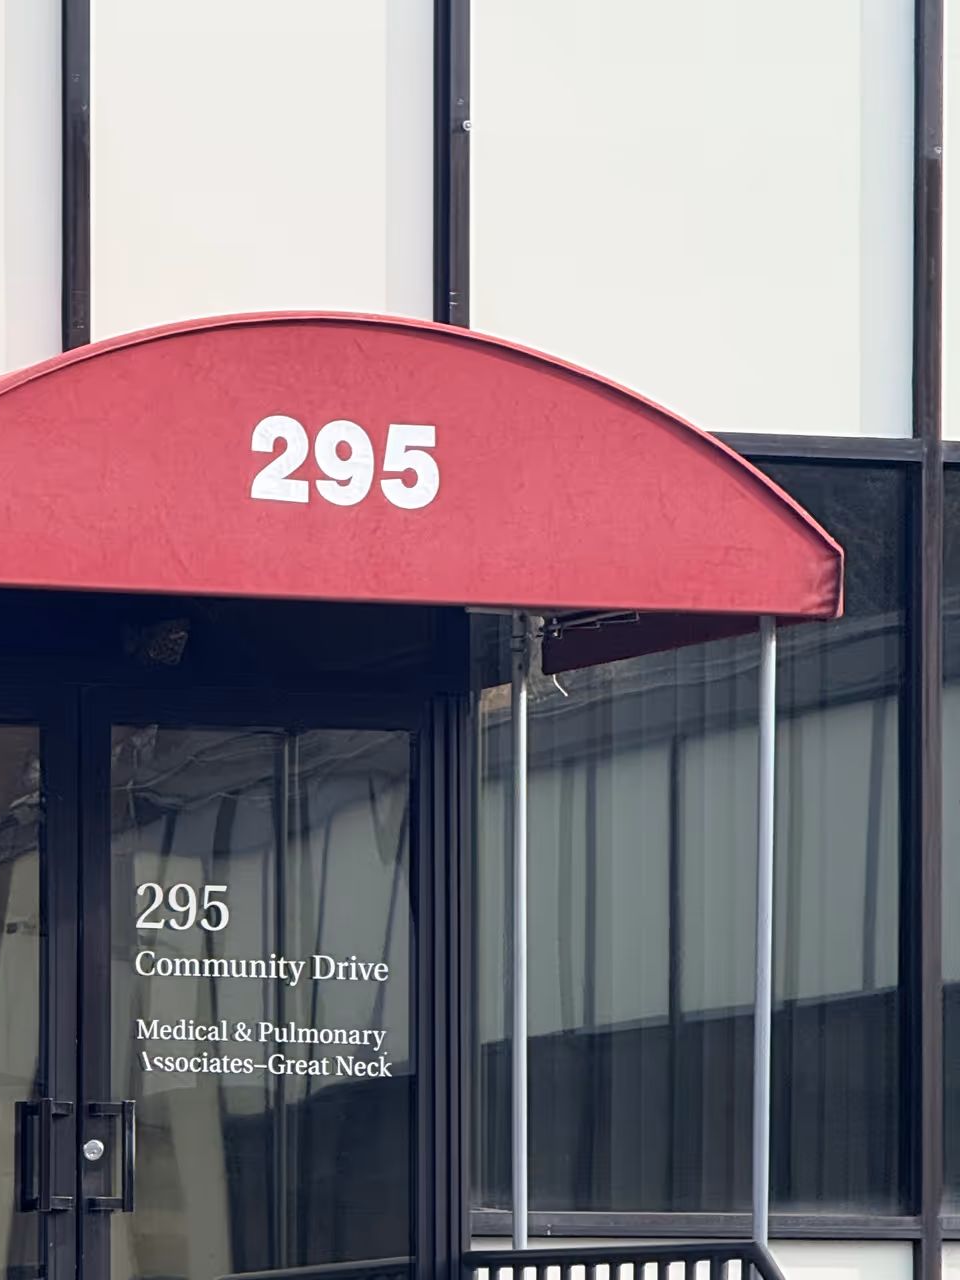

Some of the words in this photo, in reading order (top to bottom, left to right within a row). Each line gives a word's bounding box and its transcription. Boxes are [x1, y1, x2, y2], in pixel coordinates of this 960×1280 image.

[250, 414, 440, 510] 295
[135, 882, 230, 932] 295
[135, 951, 305, 986] Community
[312, 955, 390, 982] Drive
[136, 1019, 228, 1042] Medical
[234, 1021, 253, 1042] &
[258, 1021, 387, 1051] Pulmonary
[335, 1055, 393, 1078] Neck
